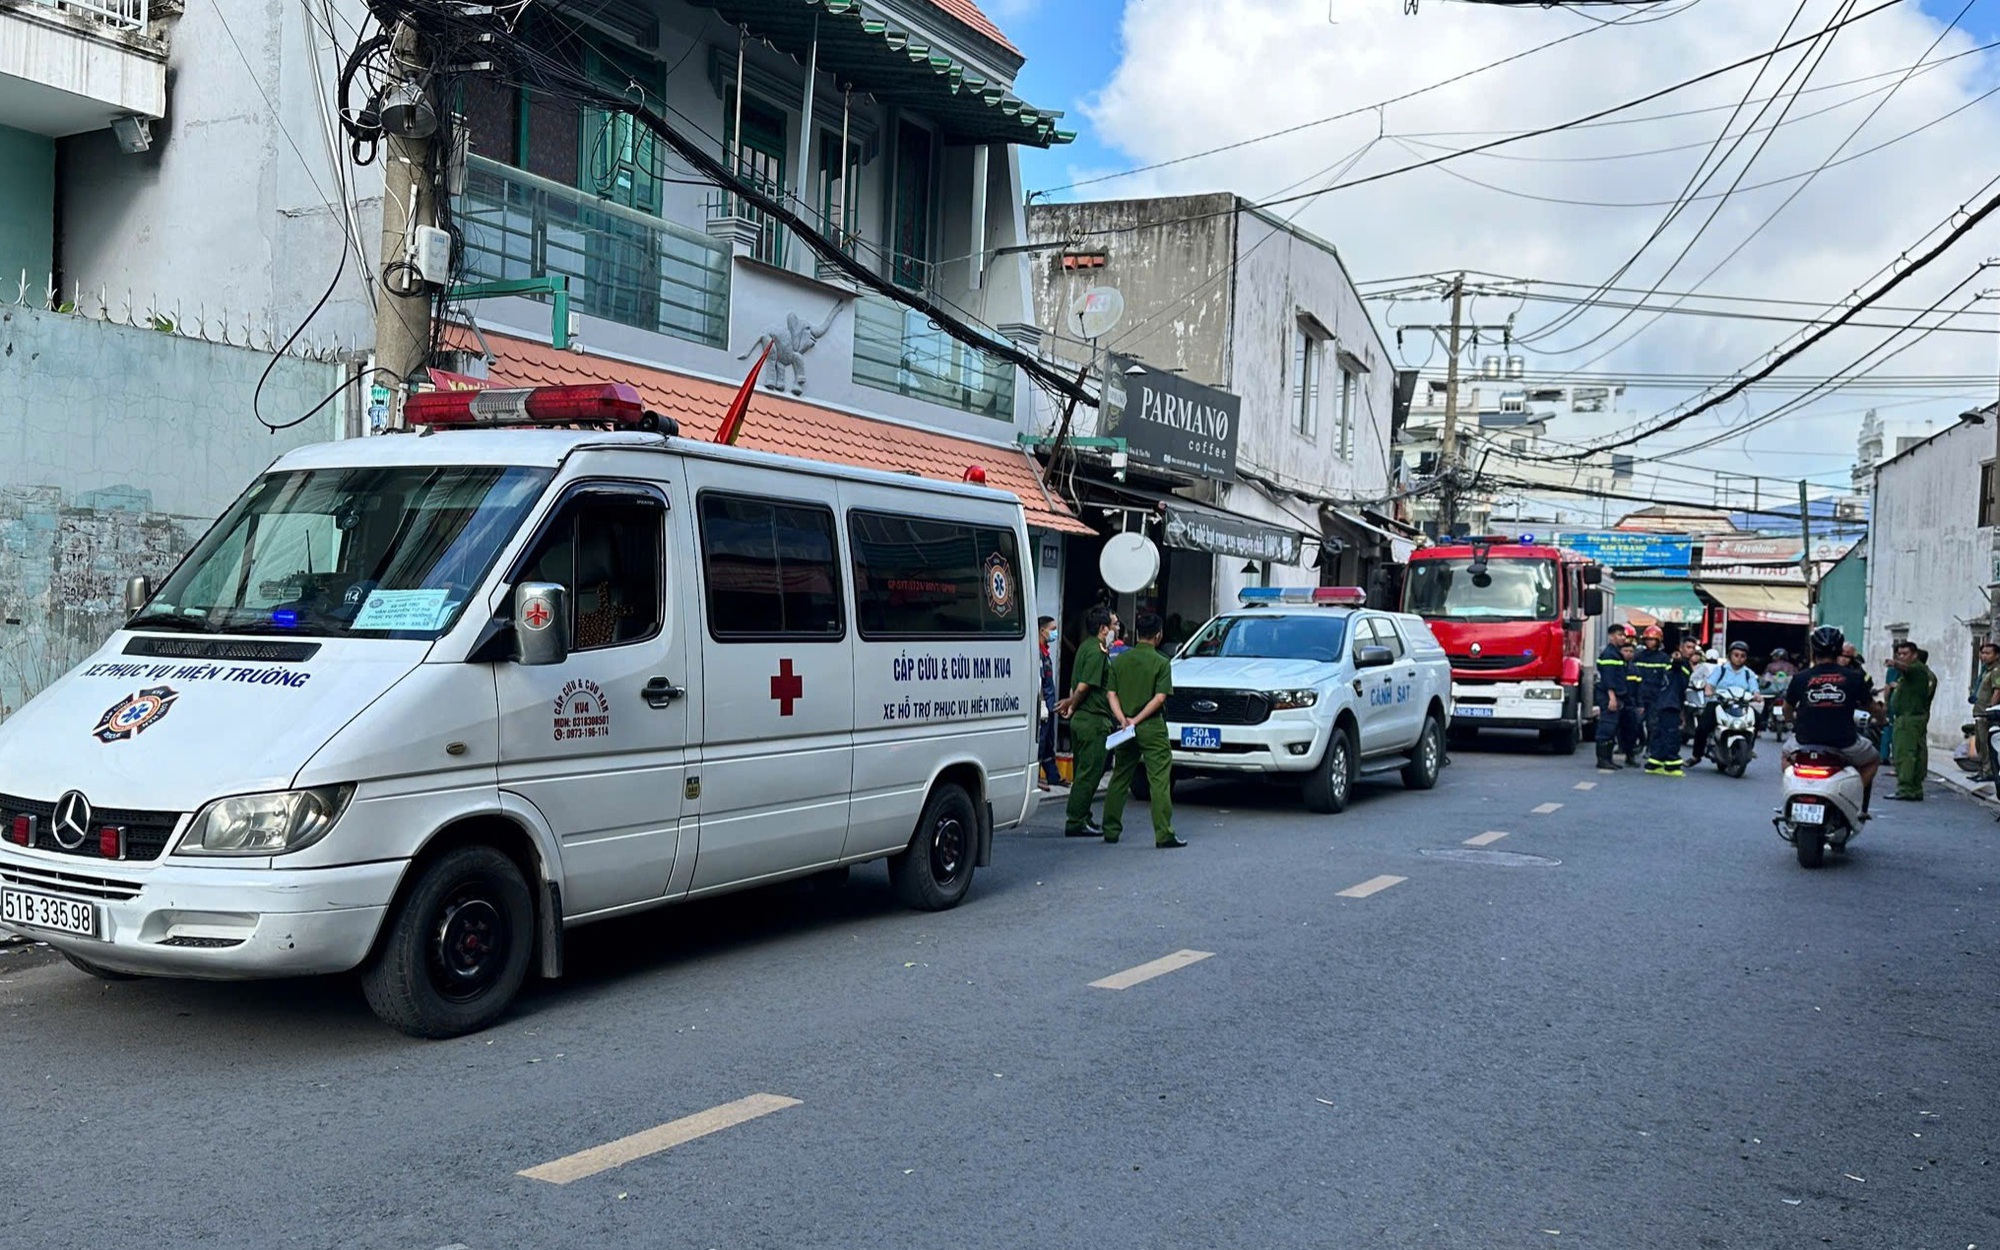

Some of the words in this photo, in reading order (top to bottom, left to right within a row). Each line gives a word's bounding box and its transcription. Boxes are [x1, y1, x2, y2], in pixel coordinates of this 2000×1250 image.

[1188, 440, 1227, 459] coffee
[99, 663, 149, 680] PHỤC
[146, 664, 172, 681] VỤ
[171, 663, 224, 682] HIỆN
[222, 665, 311, 688] TRƯỜNG
[893, 649, 915, 681] CẤP
[917, 653, 938, 681] CỨU
[941, 659, 948, 679] &
[951, 653, 970, 679] CỨU
[973, 657, 991, 683] NẠN
[994, 657, 1011, 679] KV4
[883, 703, 895, 720] XE
[898, 695, 911, 719] HỖ
[913, 700, 932, 721] TRỢ
[934, 700, 956, 719] PHỤC
[958, 699, 968, 718] VỤ
[971, 695, 989, 717] HIỆN
[990, 692, 1019, 711] TRƯỜNG
[1185, 736, 1217, 748] 021.02
[1192, 728, 1210, 738] 50A
[5, 892, 90, 932] 51B-335.98
